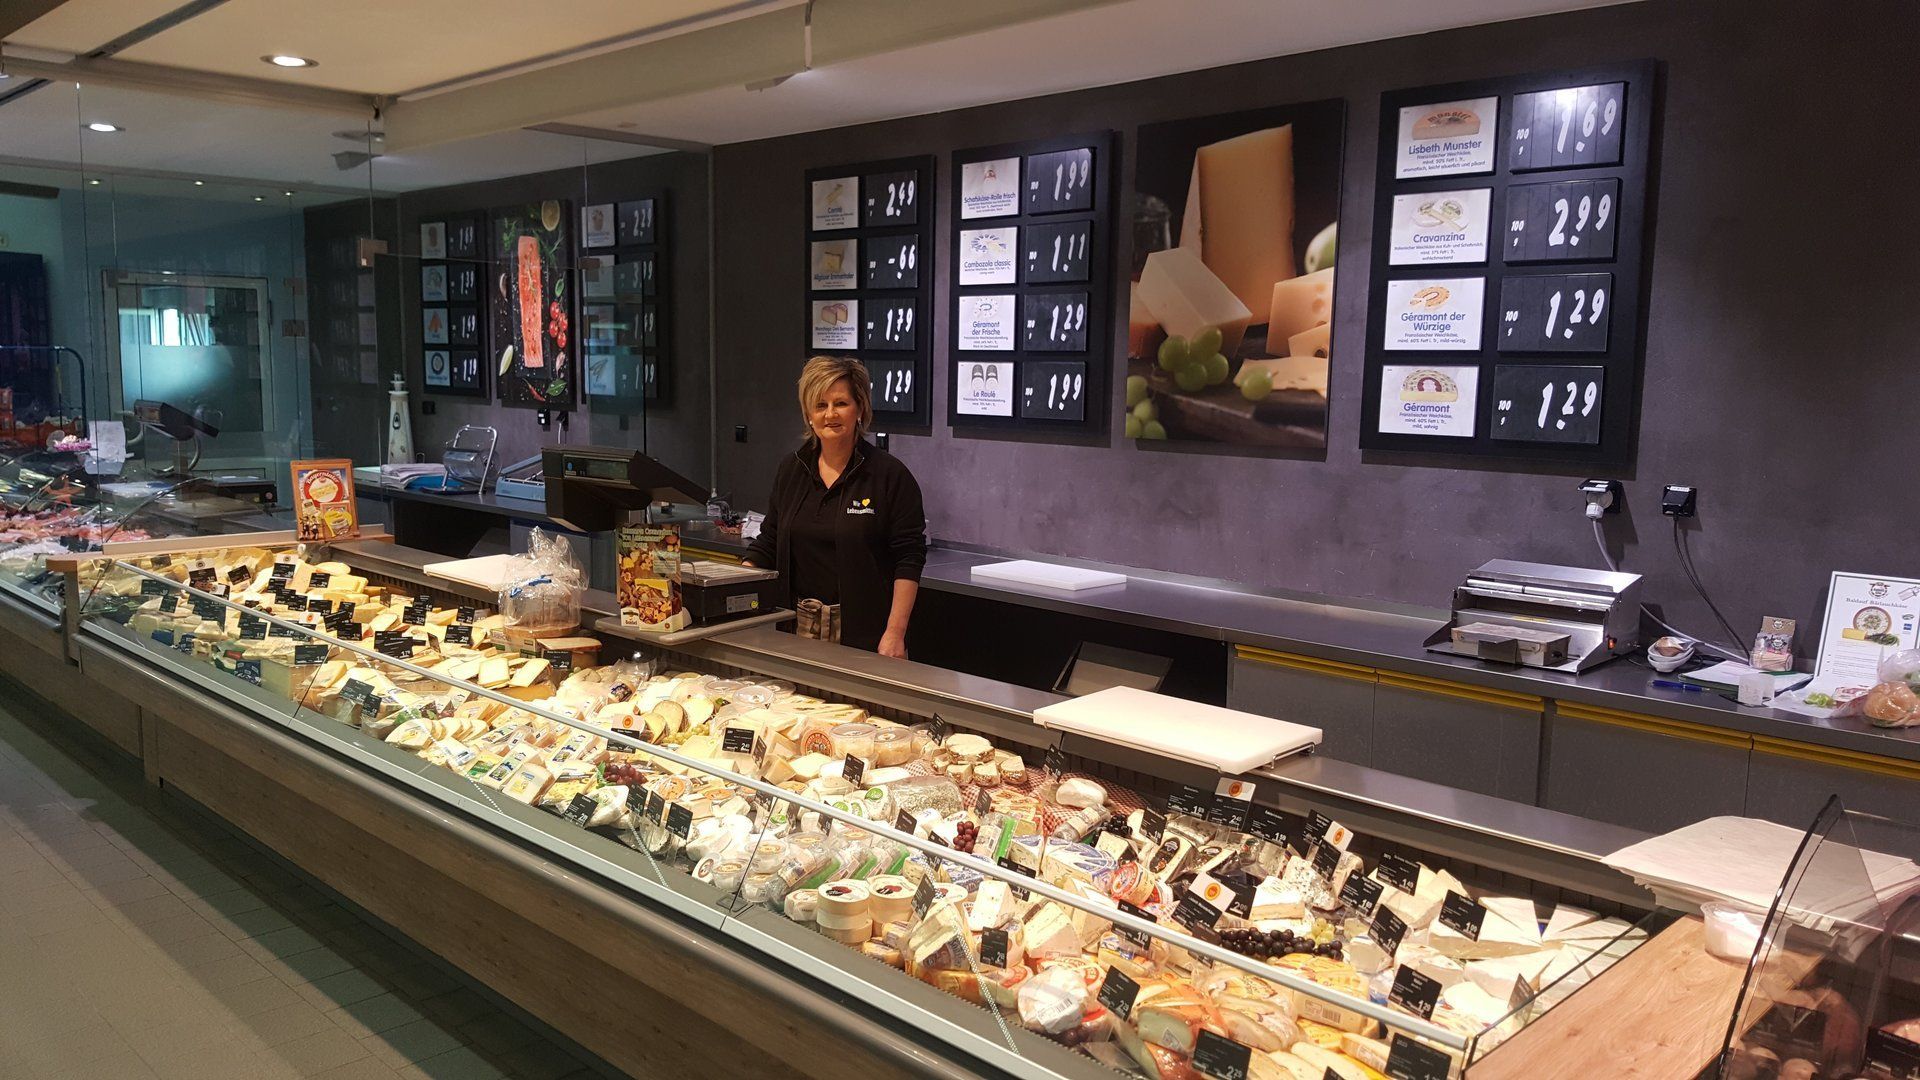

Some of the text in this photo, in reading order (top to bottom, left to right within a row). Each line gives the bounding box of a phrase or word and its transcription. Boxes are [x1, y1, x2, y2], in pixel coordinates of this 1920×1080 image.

[1408, 140, 1482, 154] Lisbeth Munster
[1054, 160, 1088, 201] 1.99
[886, 180, 914, 216] 2.49
[1511, 220, 1524, 232] 100
[1548, 194, 1611, 246] 2.99
[1413, 232, 1465, 243] Cravanzina
[1050, 303, 1084, 342] 1.29
[1401, 312, 1465, 321] Géramont der
[1505, 310, 1519, 322] 100
[1546, 288, 1605, 339] 1.29
[1414, 322, 1451, 332] Würzige
[885, 370, 912, 403] 1.29
[1048, 374, 1082, 410] 1.99
[1404, 403, 1450, 412] Géramont
[1498, 400, 1512, 411] 100
[1538, 381, 1597, 430] 1.29
